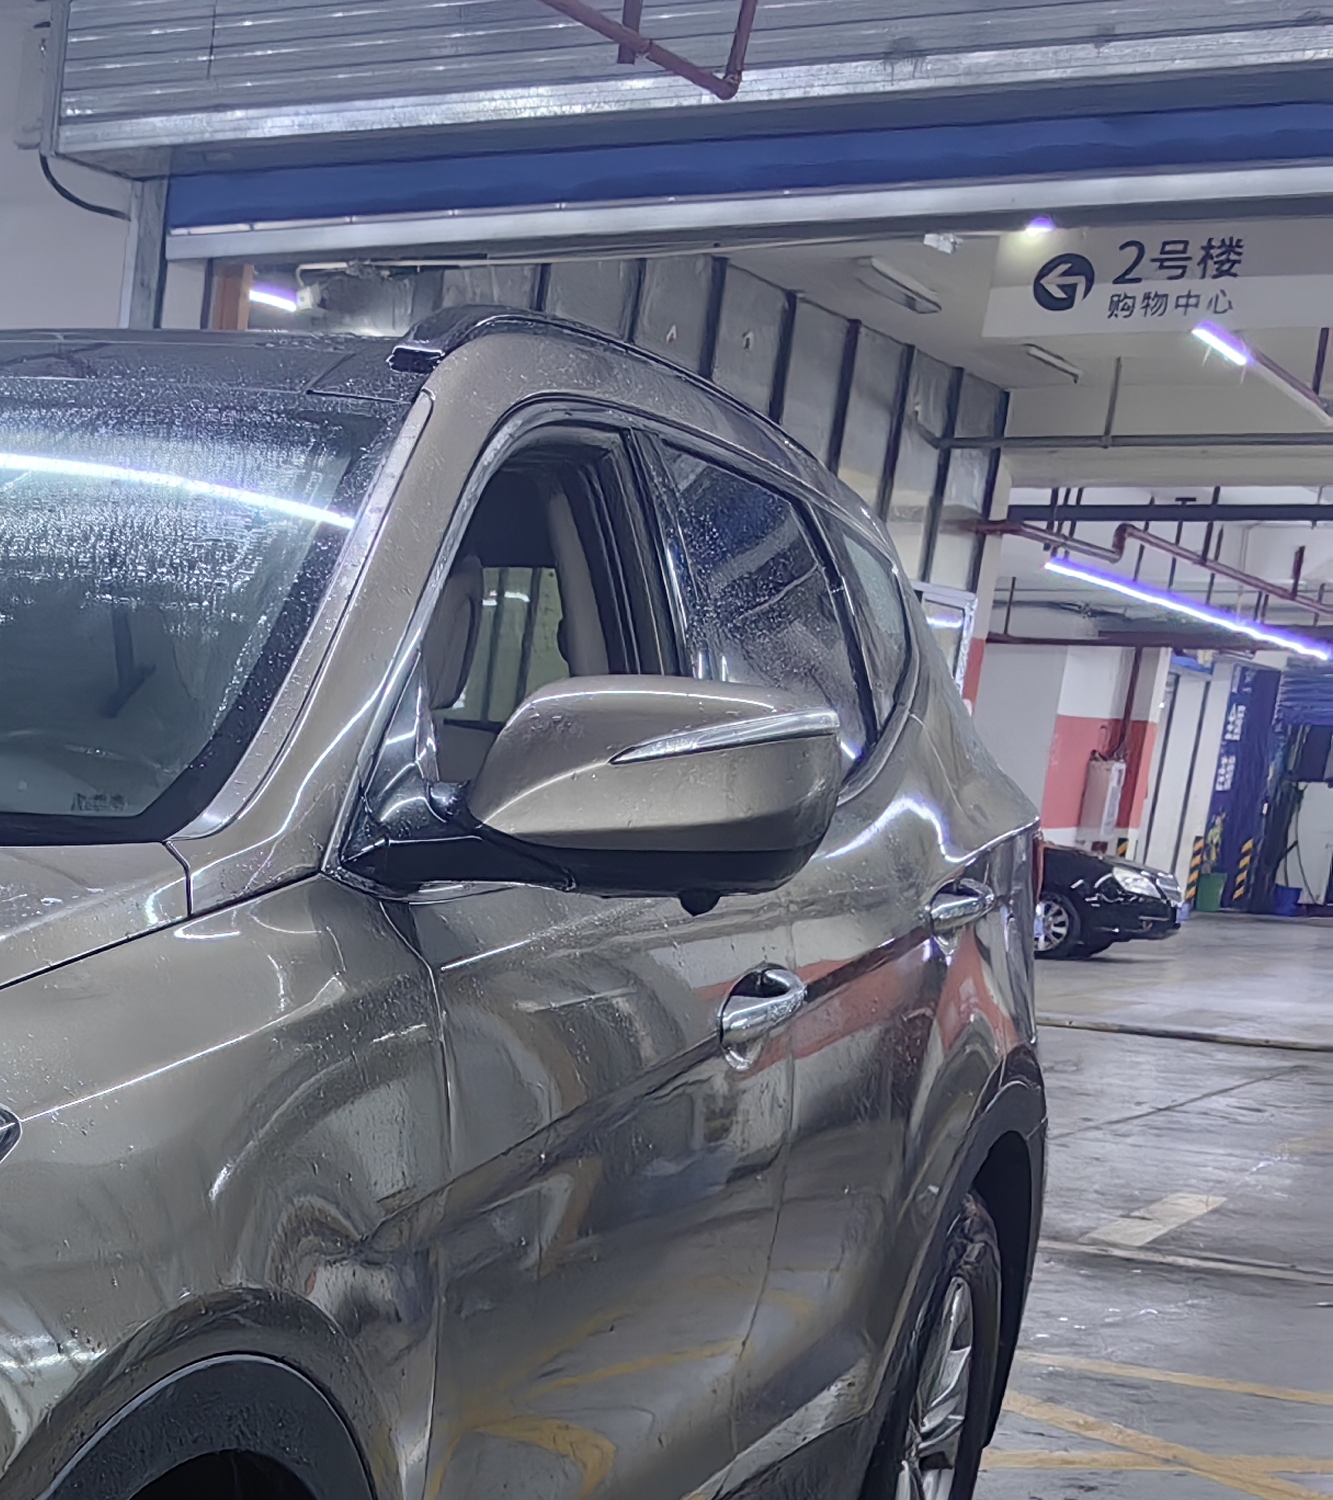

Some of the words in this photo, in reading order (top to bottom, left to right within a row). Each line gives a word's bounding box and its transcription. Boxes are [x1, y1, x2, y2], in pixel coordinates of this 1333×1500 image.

[1112, 237, 1244, 284] 2号楼
[1107, 289, 1234, 319] 购物中心
